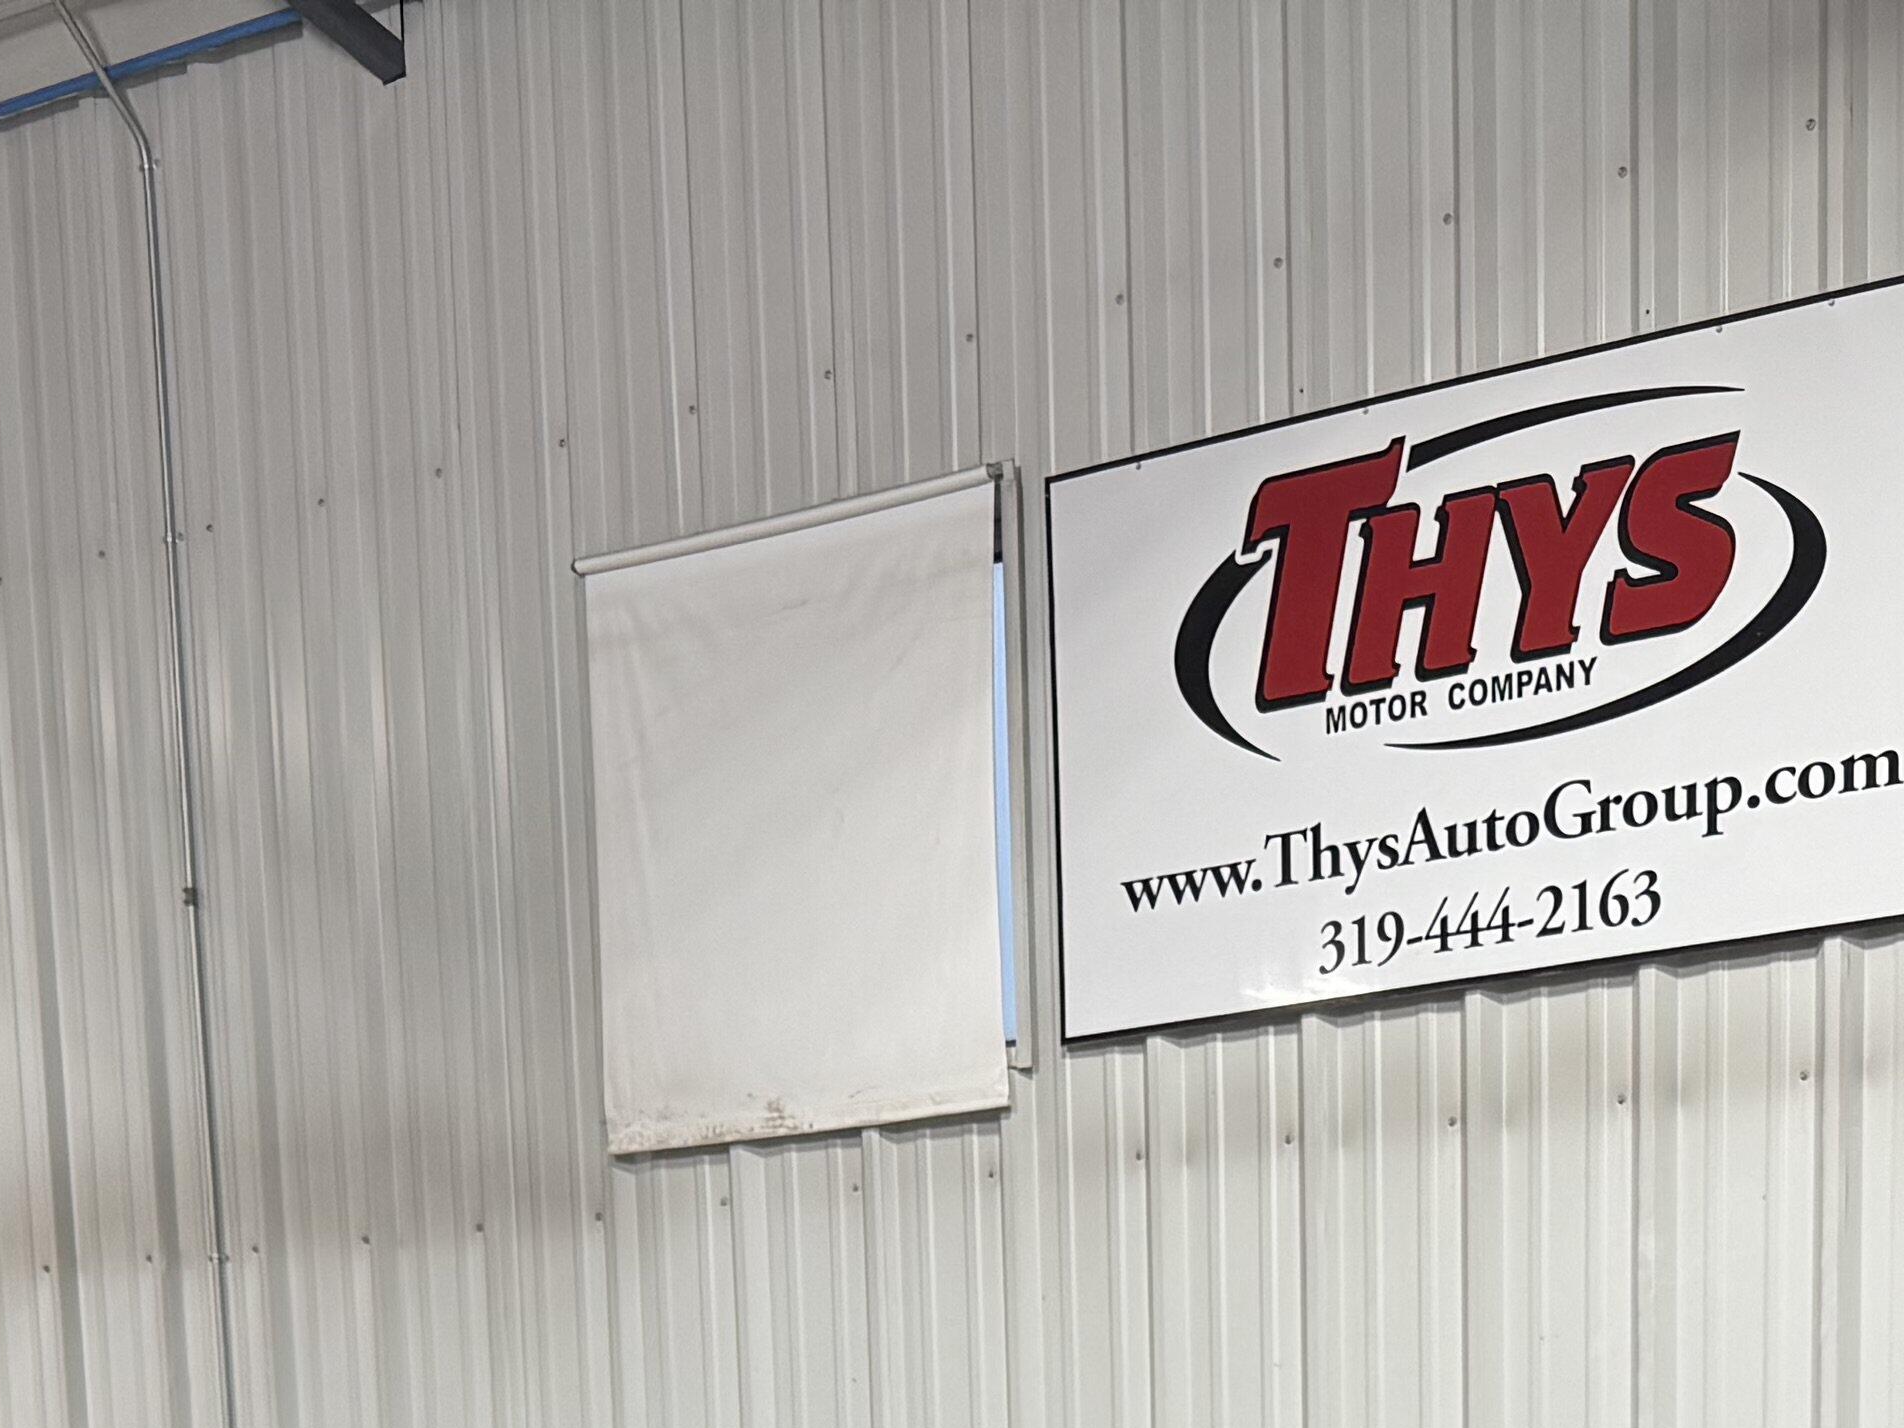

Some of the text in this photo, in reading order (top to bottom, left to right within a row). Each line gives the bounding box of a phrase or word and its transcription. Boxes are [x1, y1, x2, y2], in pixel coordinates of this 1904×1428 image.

[1238, 432, 1742, 713] THYS
[1324, 655, 1598, 735] MOTOR COMPANY
[1121, 747, 1903, 911] www.ThysAutoGroup.com
[1319, 867, 1664, 974] 319-444-2163
